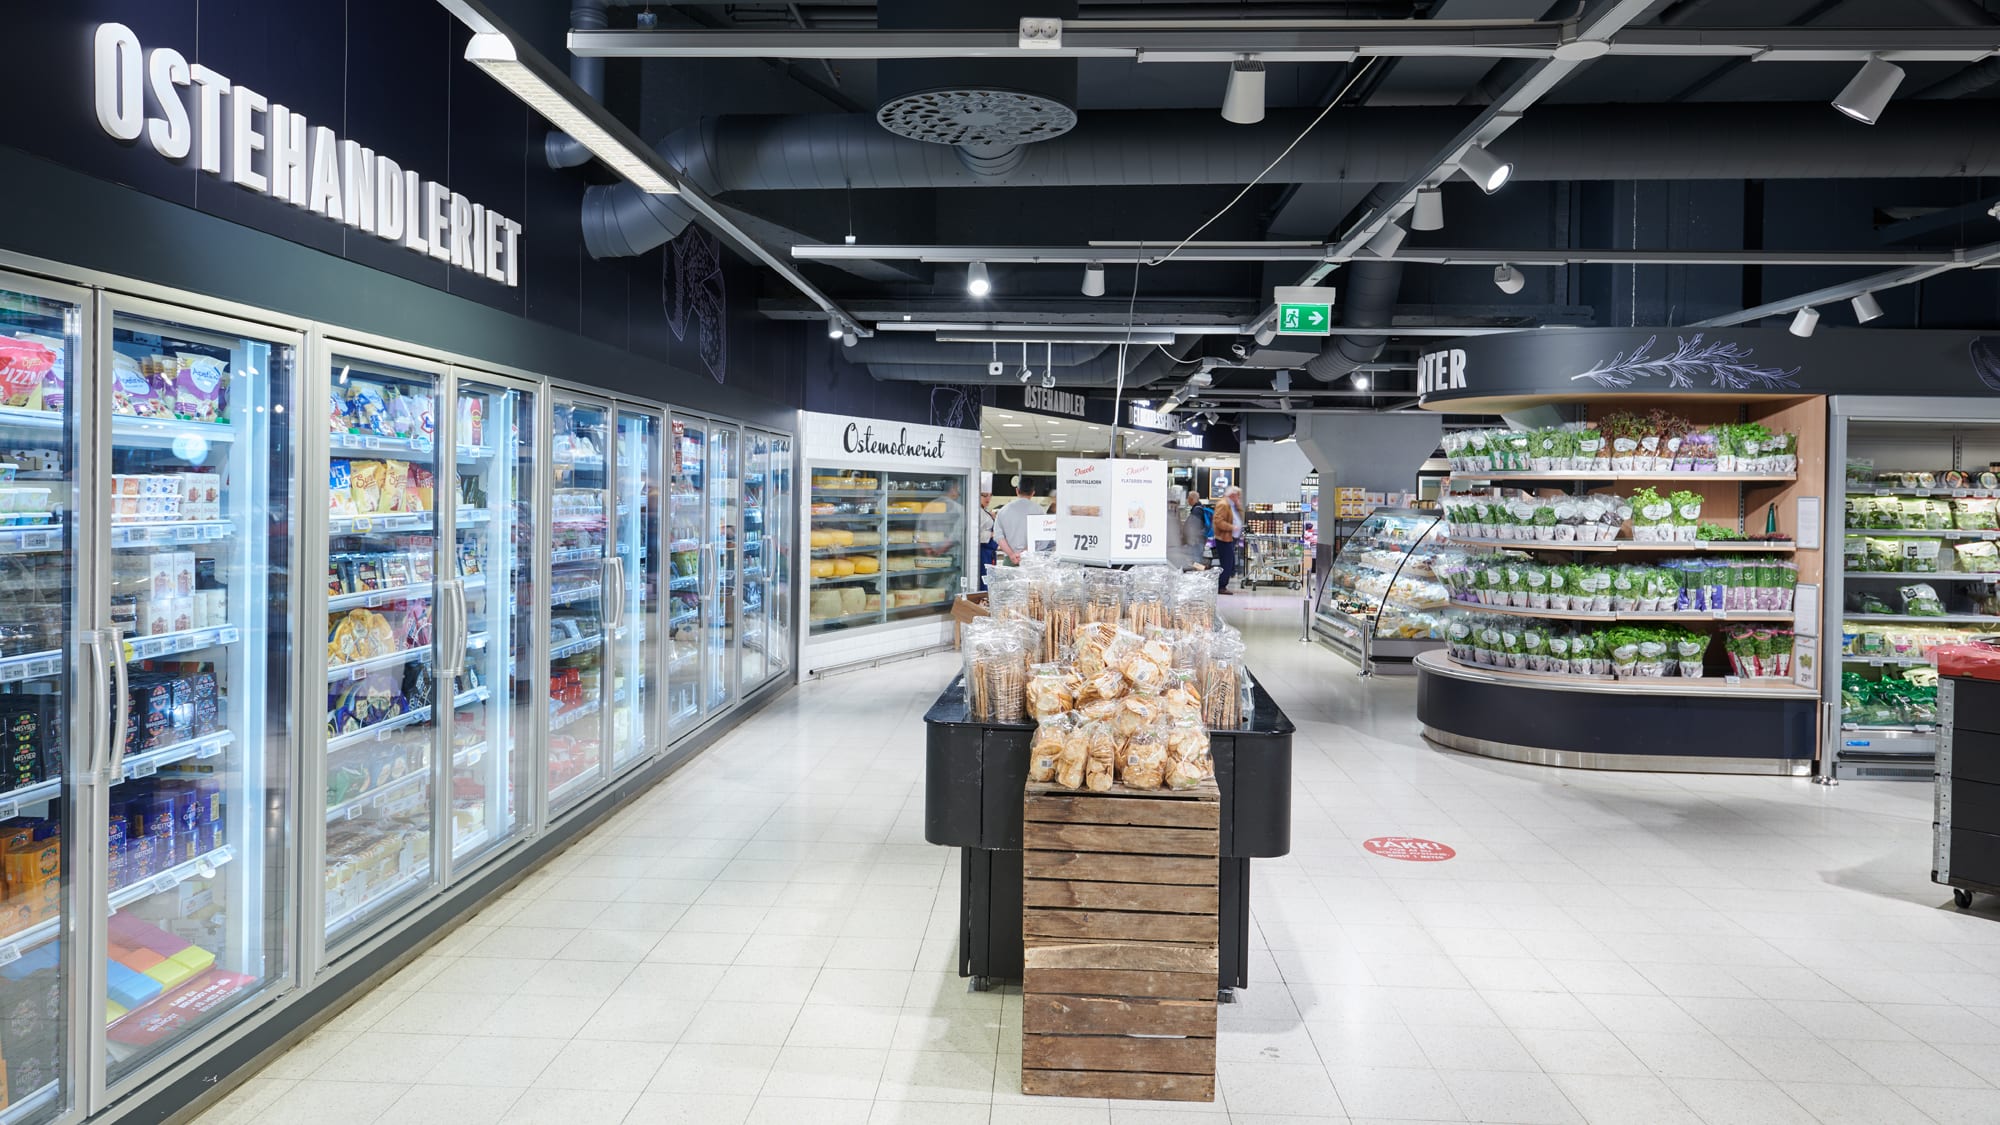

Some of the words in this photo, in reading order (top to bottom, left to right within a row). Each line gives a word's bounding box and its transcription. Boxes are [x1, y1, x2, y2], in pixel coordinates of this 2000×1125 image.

[95, 22, 522, 287] OSTEHANDLERIET
[1024, 384, 1086, 417] OSTEHANDLER
[843, 422, 946, 459] Ostemodneriet
